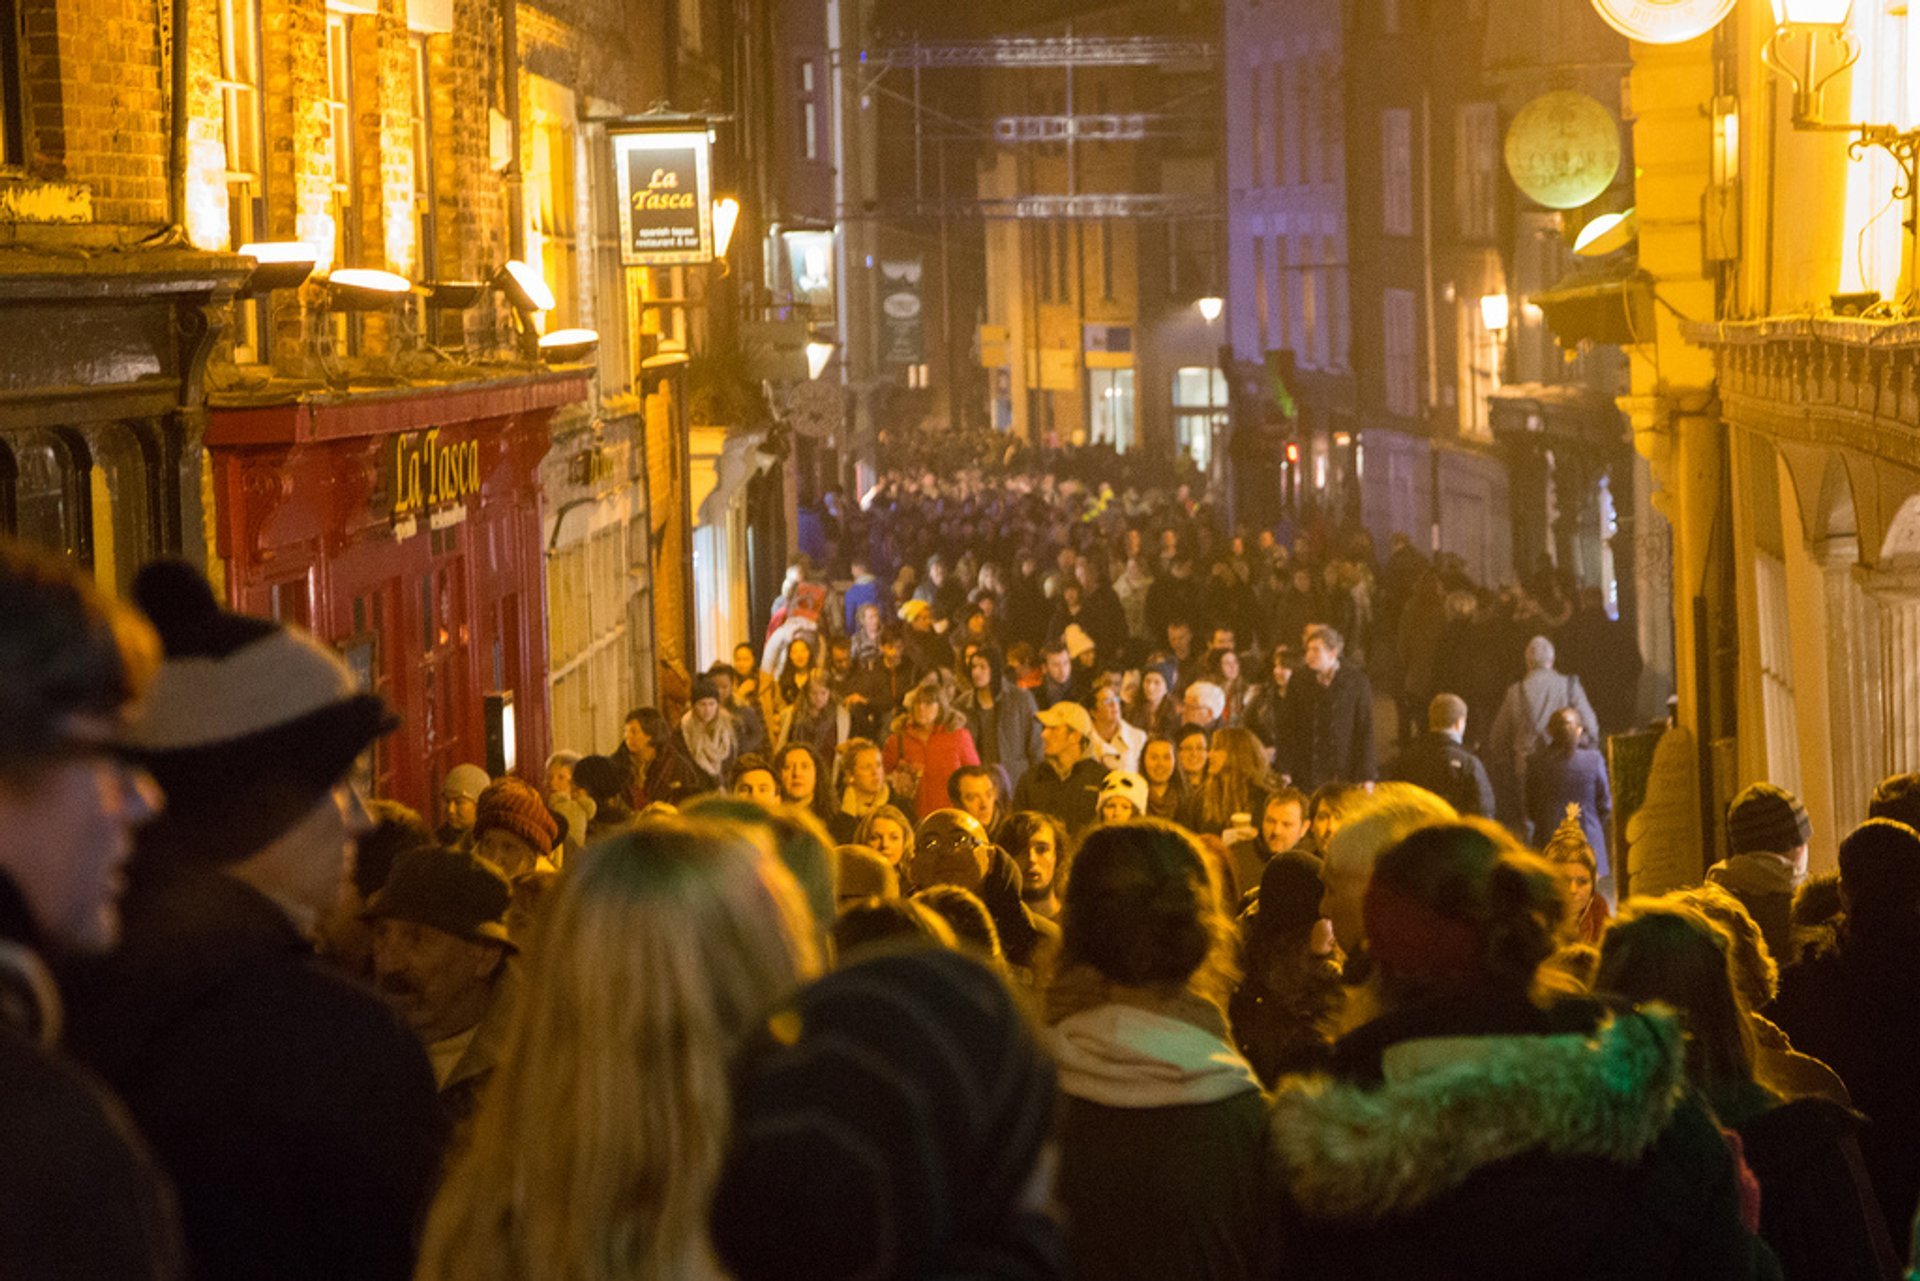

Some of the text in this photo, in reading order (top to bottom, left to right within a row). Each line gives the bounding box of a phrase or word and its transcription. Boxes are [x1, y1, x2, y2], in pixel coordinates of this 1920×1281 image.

[648, 168, 678, 189] La
[631, 189, 695, 211] Tasca
[395, 433, 422, 513] La
[424, 427, 480, 504] Tasca
